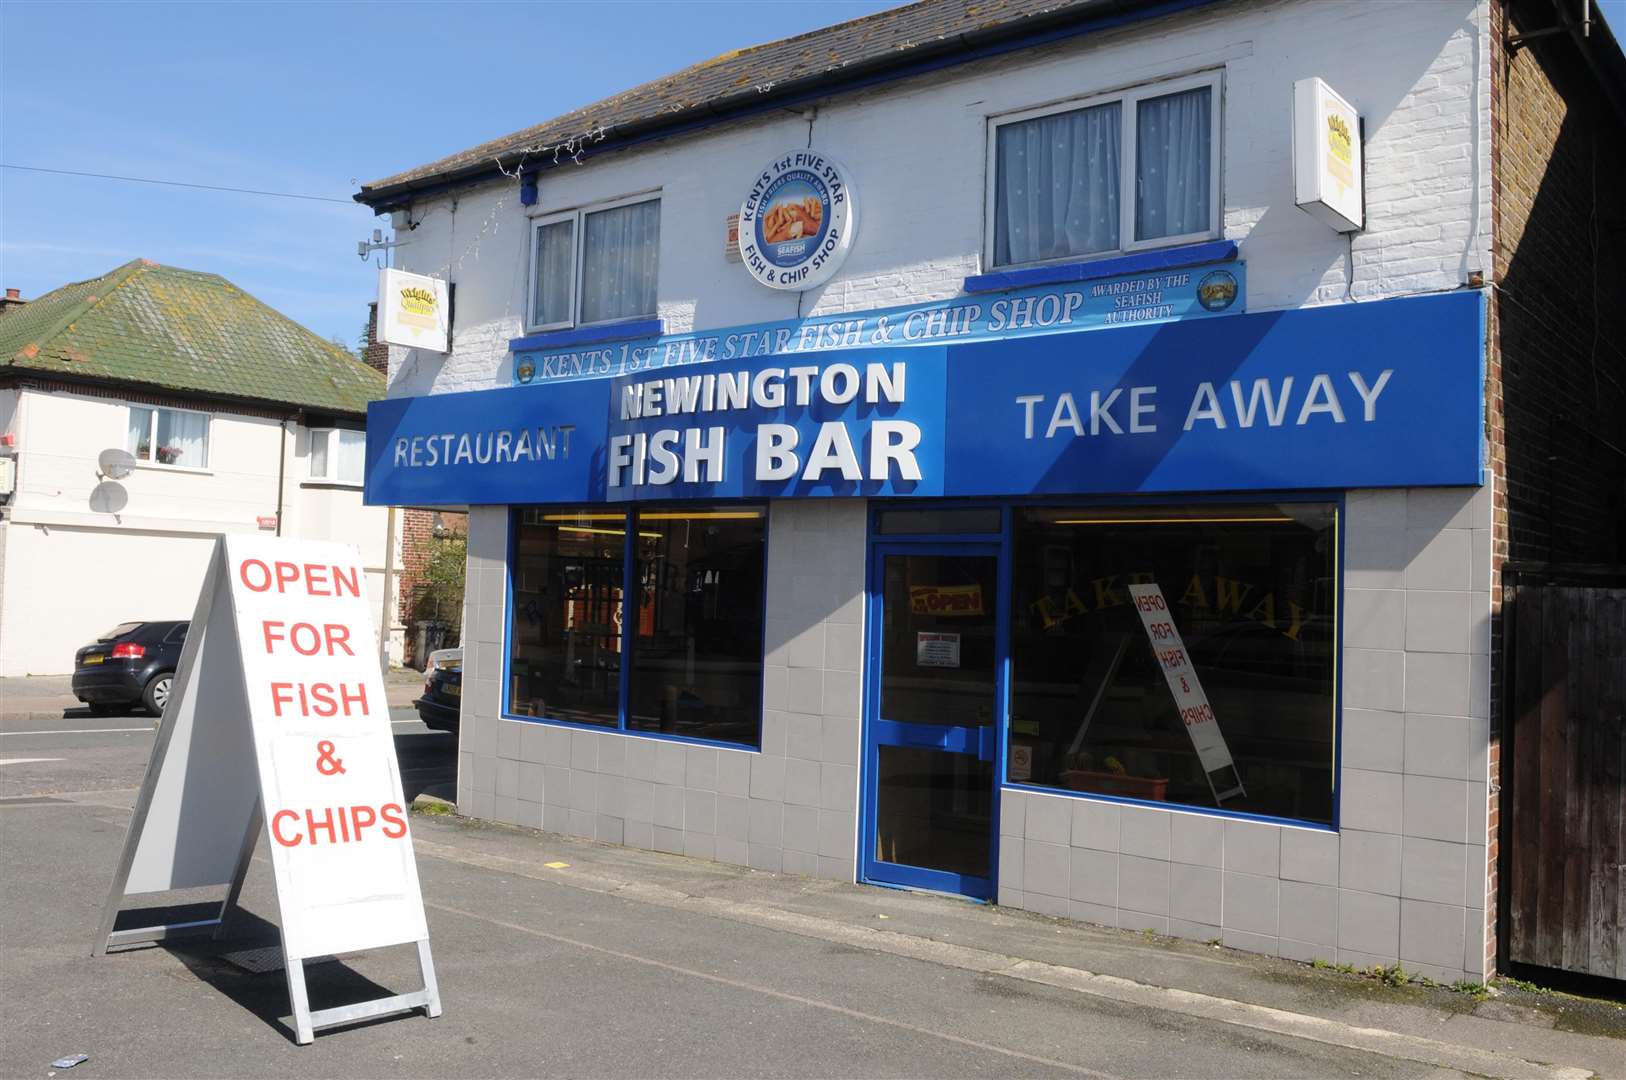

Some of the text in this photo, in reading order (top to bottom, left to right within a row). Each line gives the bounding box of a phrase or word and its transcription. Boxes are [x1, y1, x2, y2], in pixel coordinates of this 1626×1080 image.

[744, 154, 844, 221] KENTS 1st FIVE STAR
[745, 244, 766, 274] FISH
[767, 269, 776, 282] &
[780, 266, 809, 284] CHIP
[812, 228, 839, 270] SHOP
[1091, 272, 1190, 297] AWARDED BY THE
[1115, 292, 1161, 308] SEAFISH
[541, 291, 1084, 379] KENTS 1ST FIVE STAR FISH & CHIP SHOP
[1104, 304, 1173, 324] AUTHORITY
[619, 363, 906, 420] NEWINGTON
[1016, 369, 1394, 439] TAKE AWAY
[393, 425, 576, 467] RESTAURANT
[608, 420, 923, 487] FISH BAR
[240, 558, 361, 598] OPEN
[1178, 575, 1313, 640] AWAY
[262, 620, 355, 656] FOR
[271, 682, 370, 717] FISH
[316, 740, 346, 776] &
[271, 803, 407, 847] CHIPS
